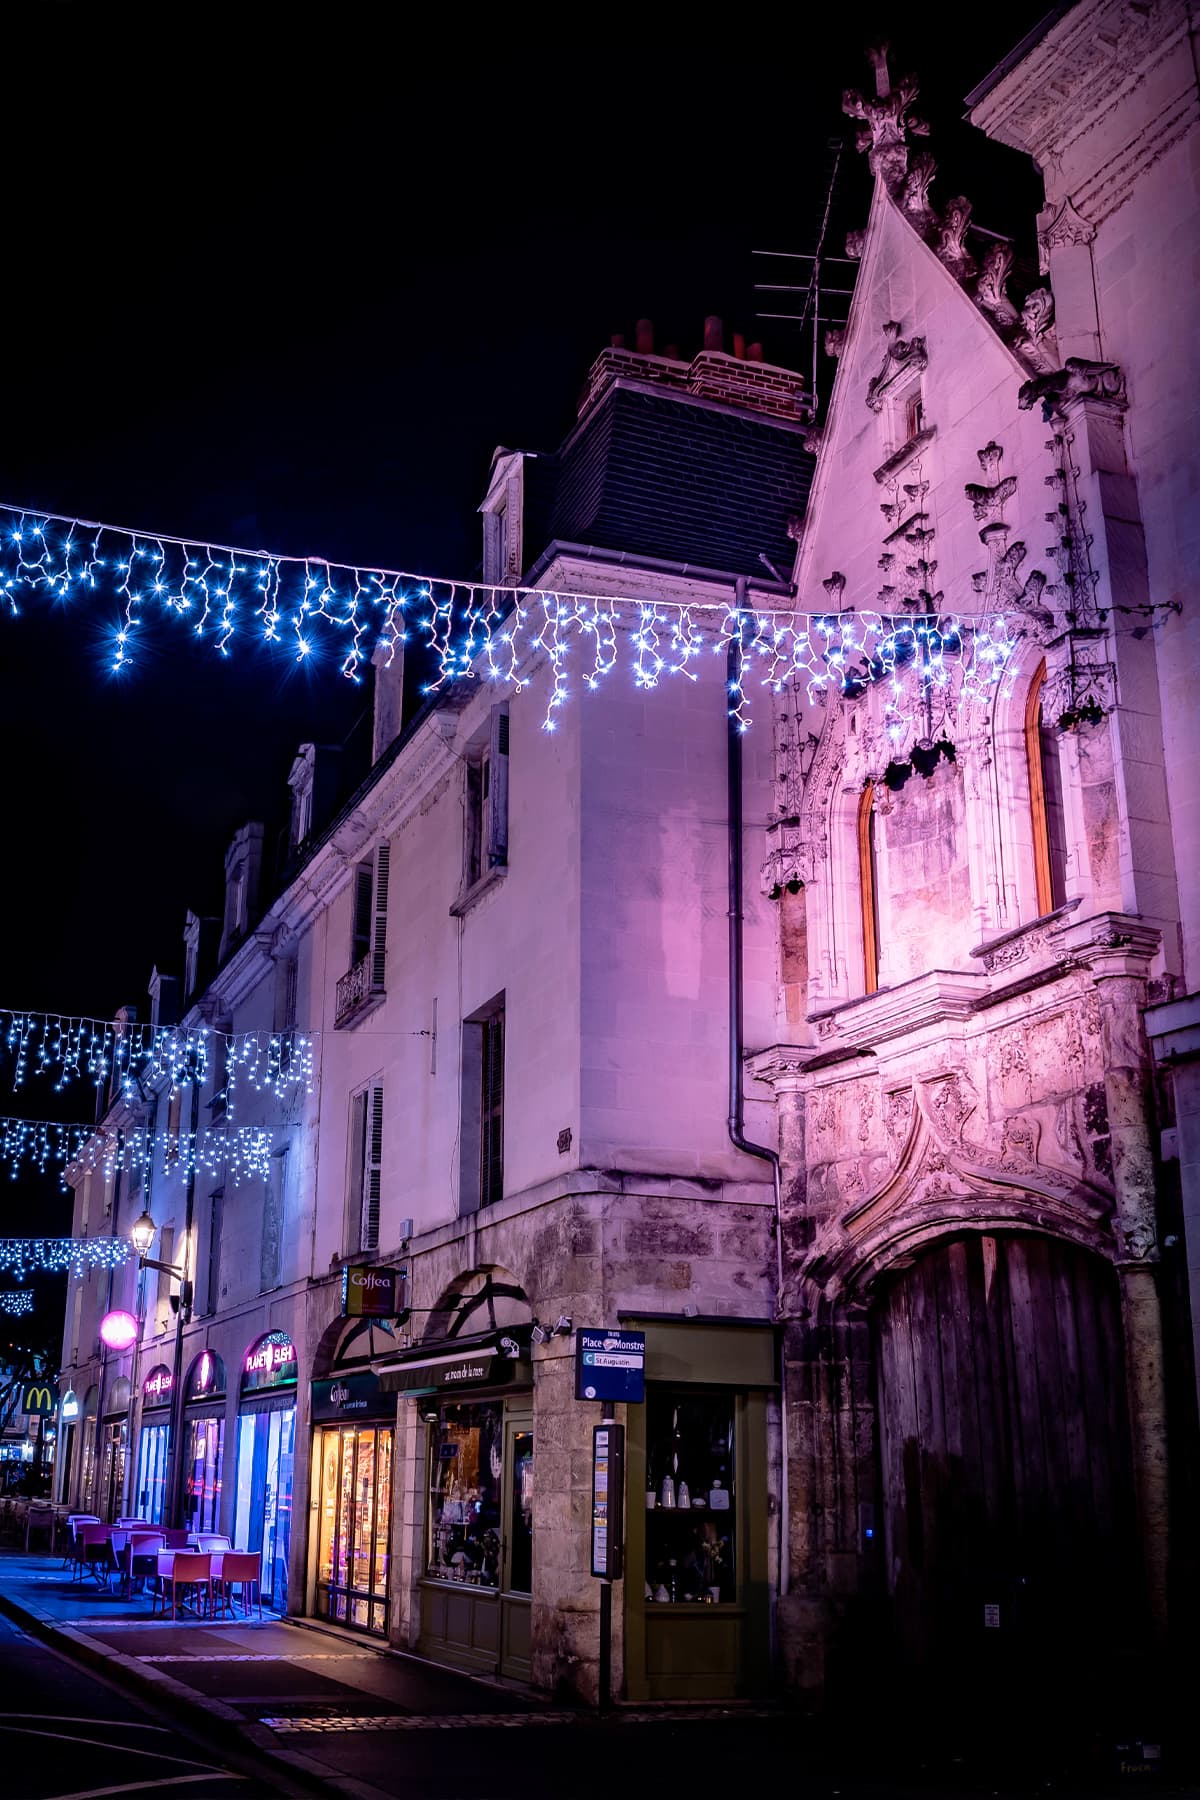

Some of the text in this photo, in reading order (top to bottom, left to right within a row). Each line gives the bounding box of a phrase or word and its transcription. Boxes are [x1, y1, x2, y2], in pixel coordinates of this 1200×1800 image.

[351, 1272, 392, 1290] Coffea
[582, 1337, 645, 1351] Place Monstre
[246, 1346, 293, 1371] PLANET SUSHI
[585, 1354, 593, 1364] C
[603, 1358, 630, 1367] Augustin
